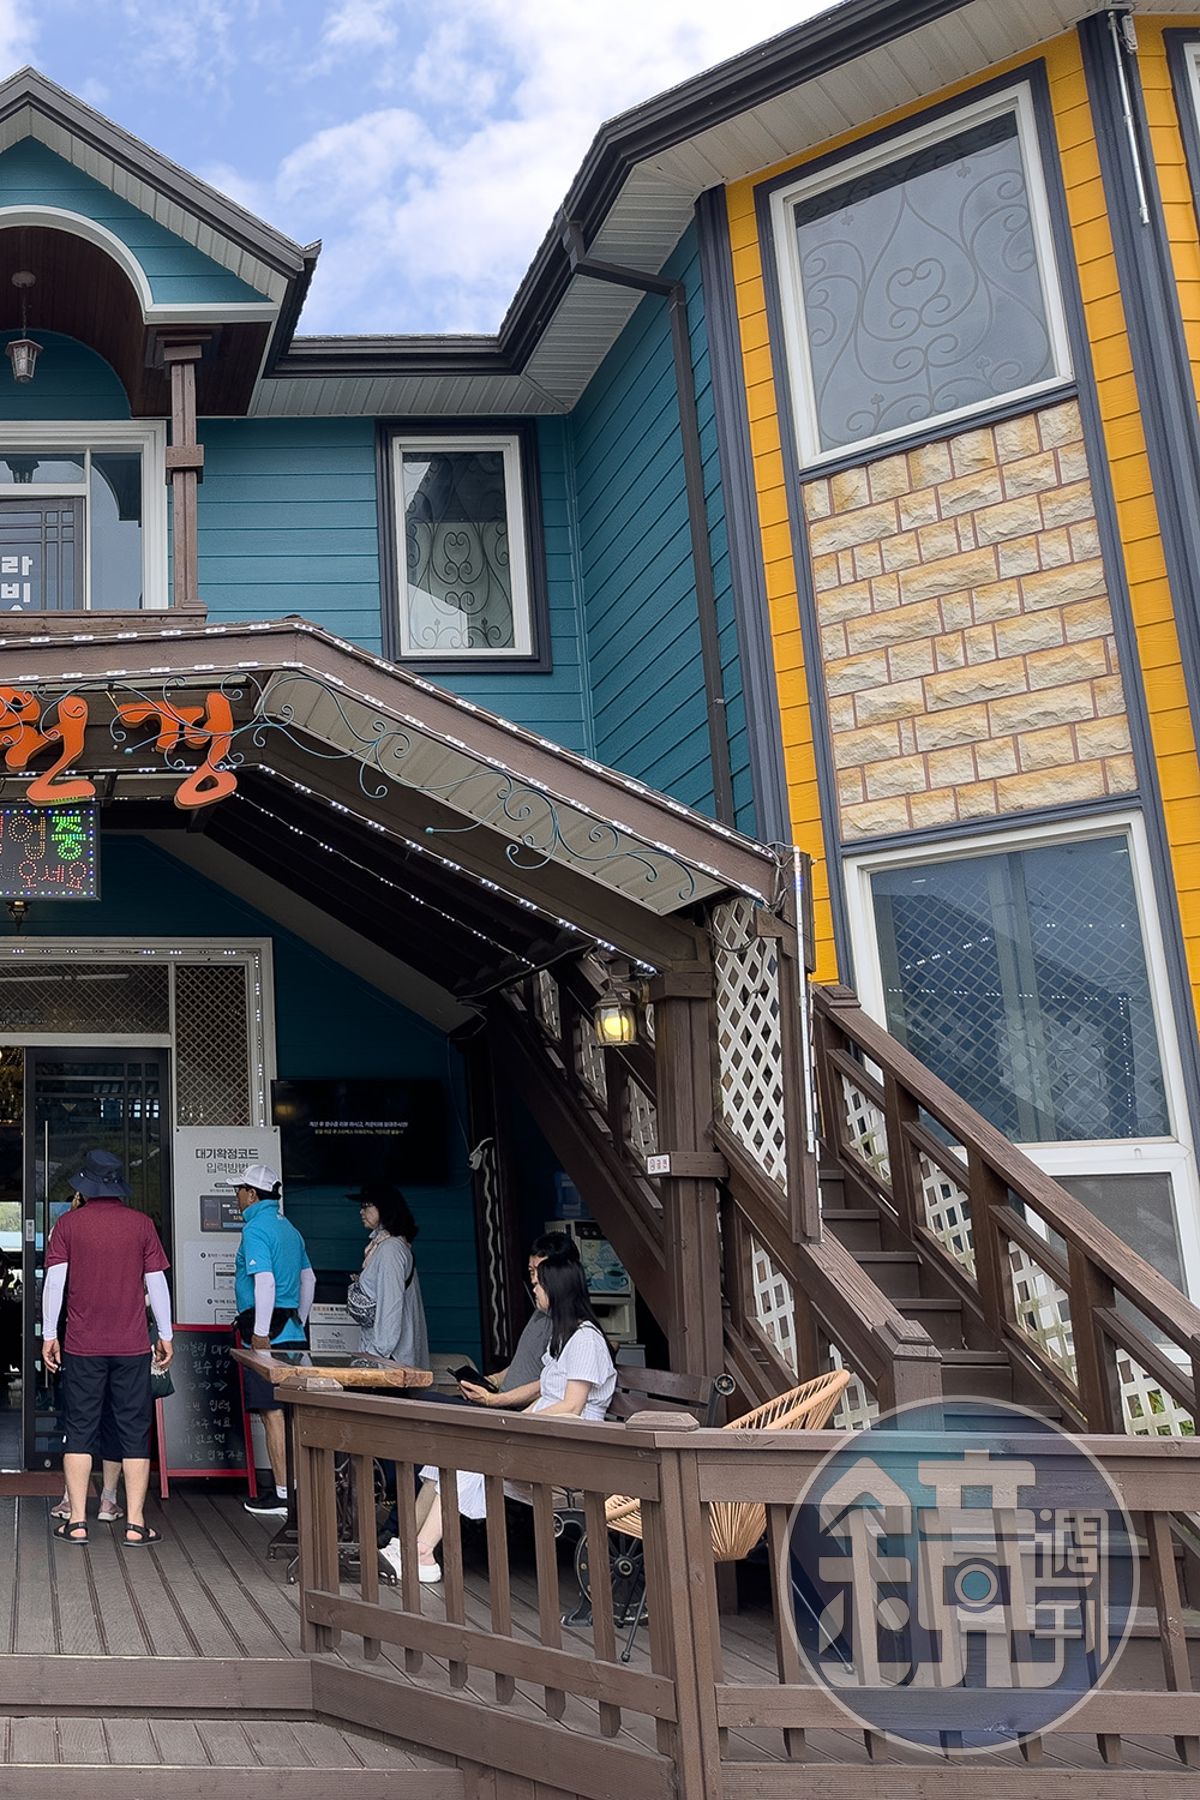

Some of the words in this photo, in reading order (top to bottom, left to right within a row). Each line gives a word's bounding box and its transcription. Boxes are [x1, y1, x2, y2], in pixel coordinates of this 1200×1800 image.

[1, 556, 33, 611] 라비
[18, 860, 88, 889] 오세요
[195, 1148, 259, 1160] 대기확정코드
